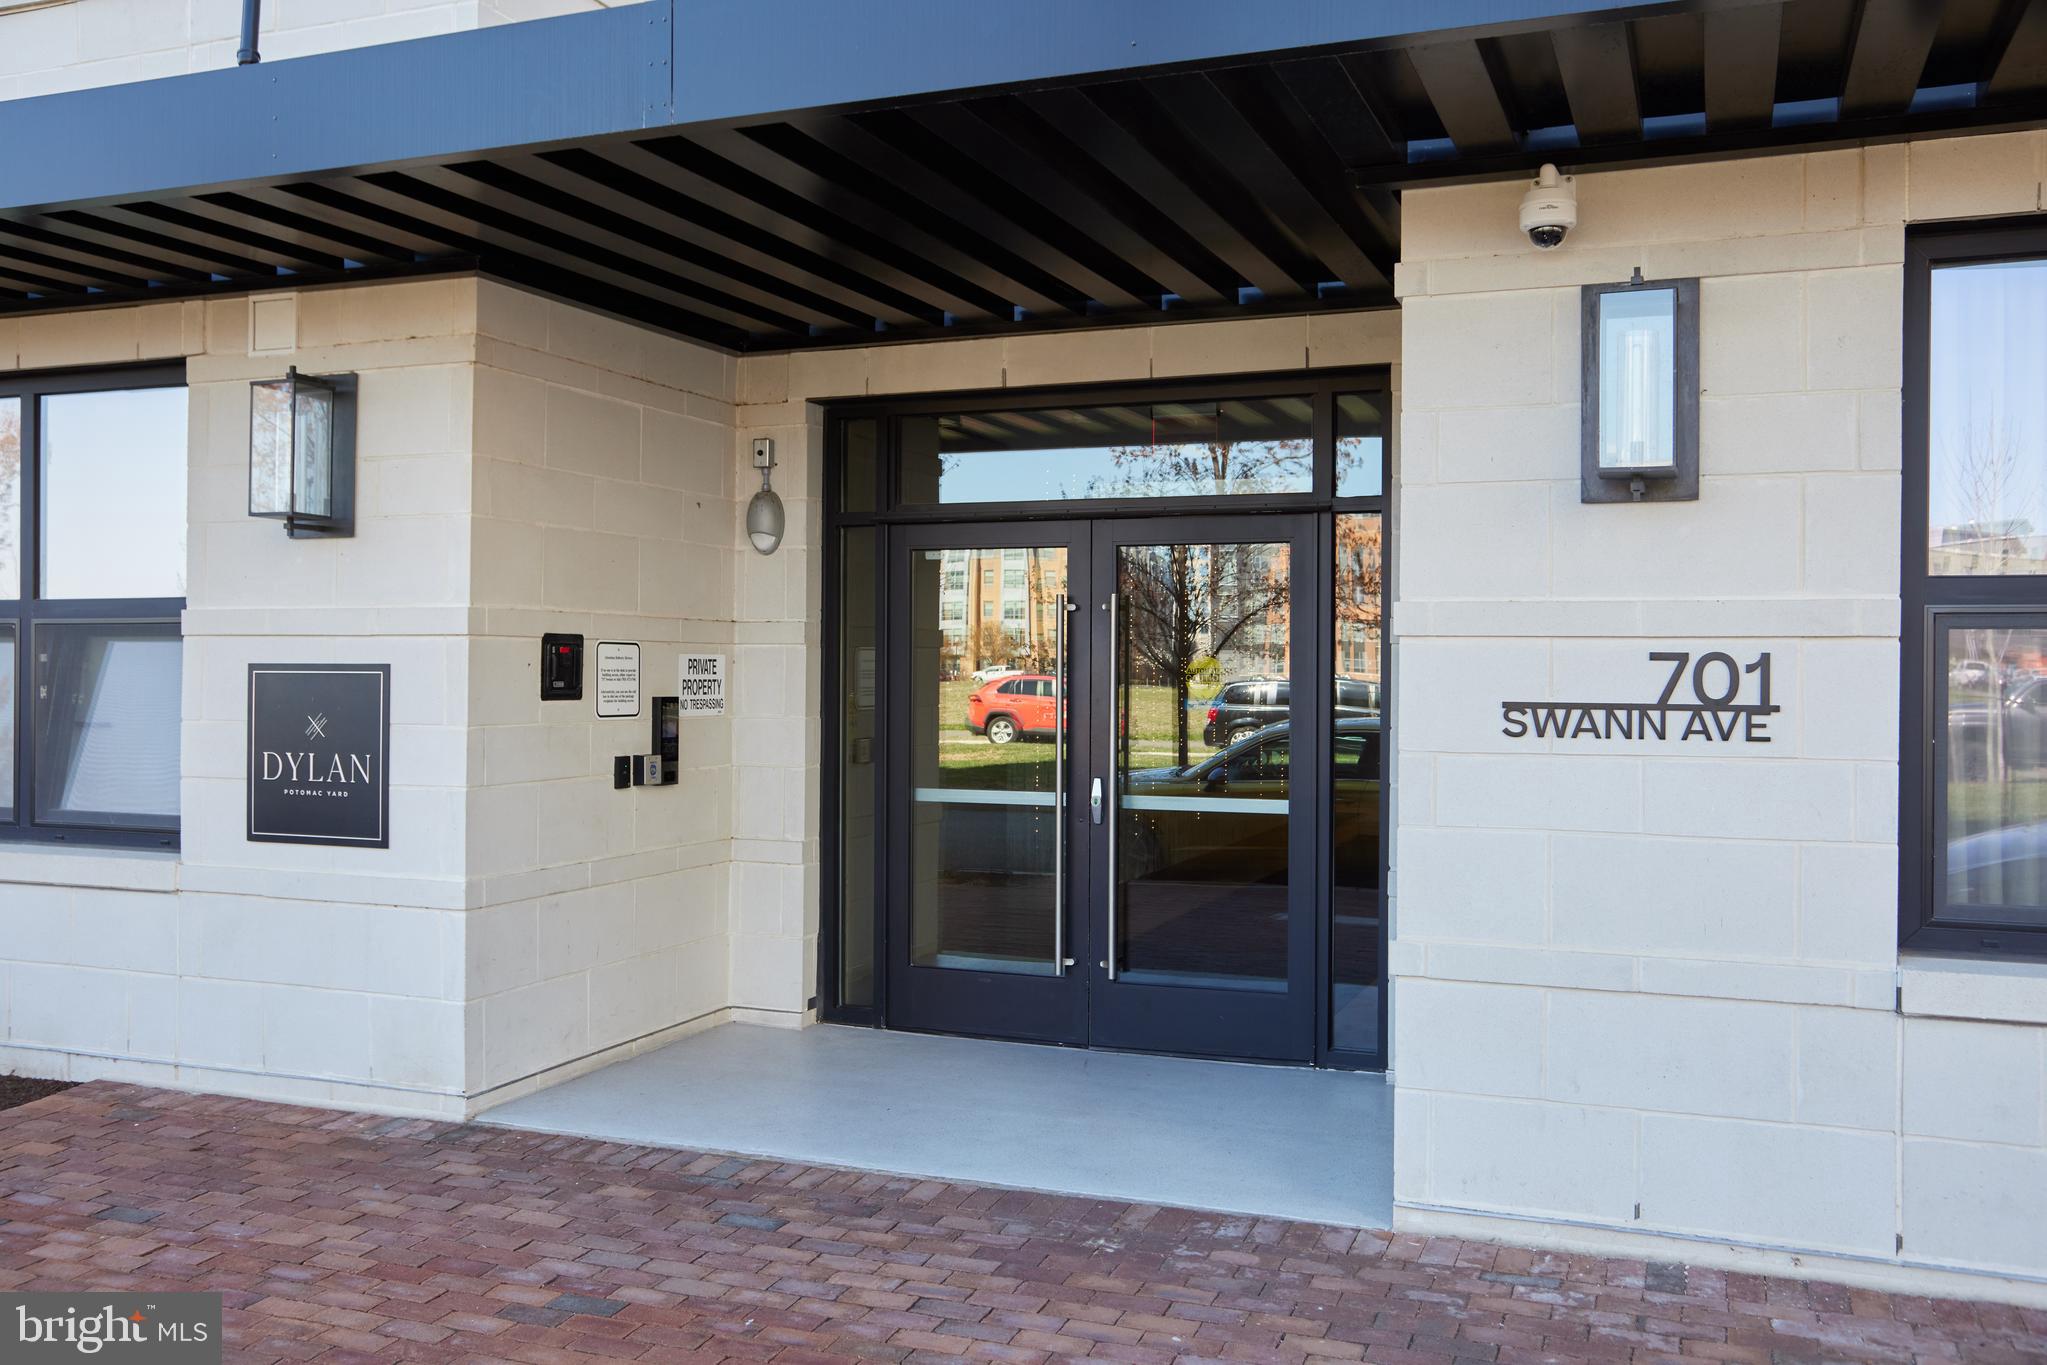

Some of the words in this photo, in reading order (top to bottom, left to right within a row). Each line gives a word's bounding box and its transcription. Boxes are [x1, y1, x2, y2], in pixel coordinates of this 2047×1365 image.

[688, 658, 717, 675] PRIVATE
[682, 679, 722, 695] PROPERTY
[1649, 651, 1772, 706] 701
[680, 699, 688, 710] NO
[690, 698, 724, 710] TRESPASSING
[1502, 704, 1667, 740] SWANN
[1681, 707, 1772, 742] AVE
[262, 751, 371, 784] DYLAN
[284, 789, 323, 797] POTOMAC
[326, 790, 349, 798] YARD
